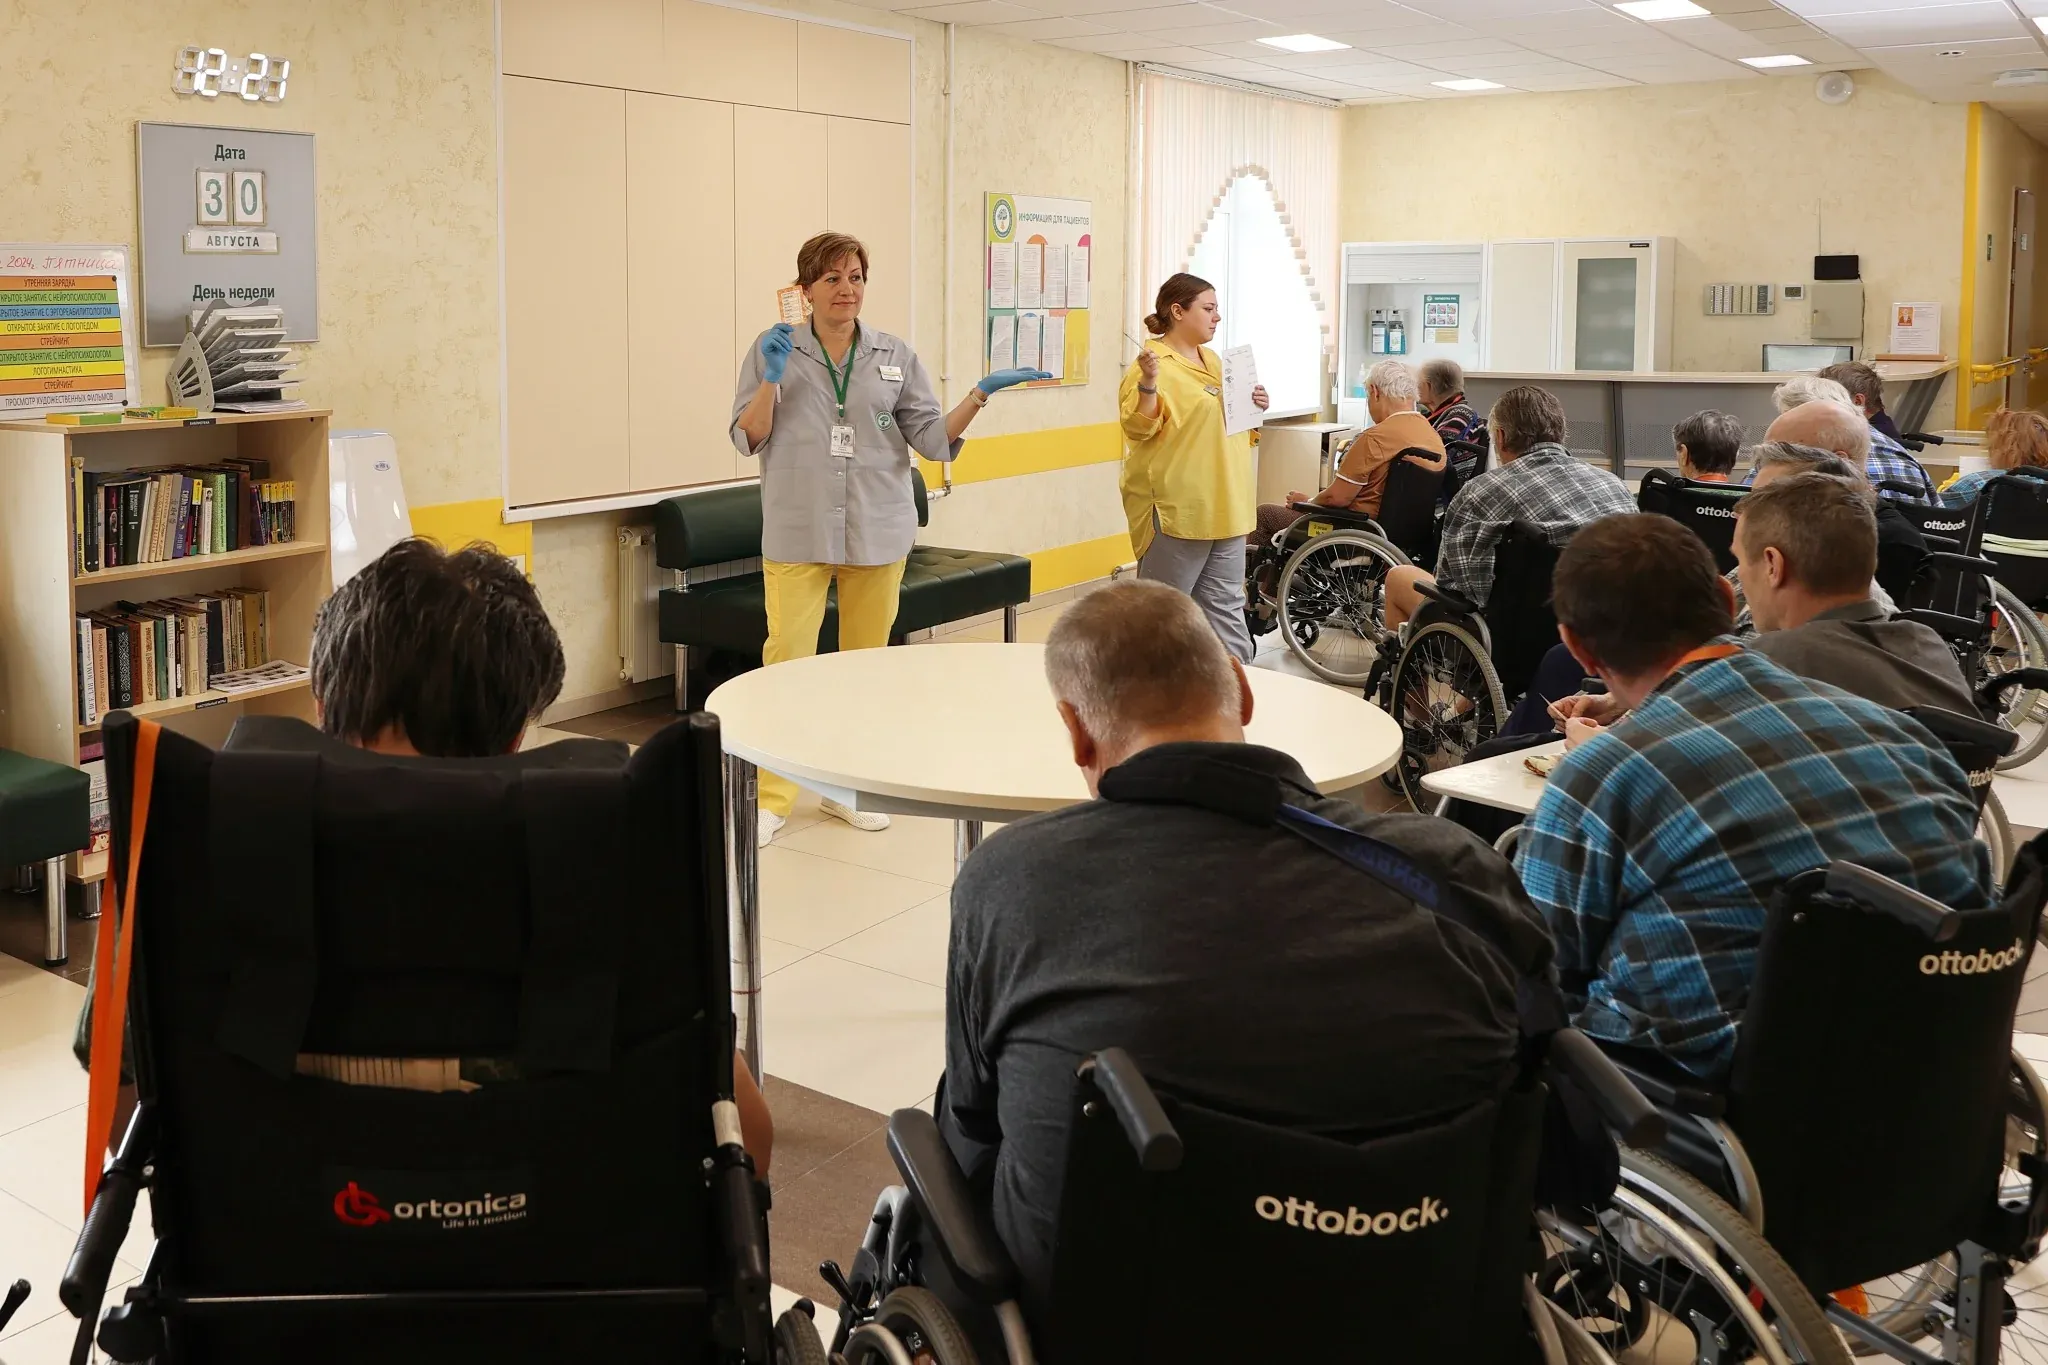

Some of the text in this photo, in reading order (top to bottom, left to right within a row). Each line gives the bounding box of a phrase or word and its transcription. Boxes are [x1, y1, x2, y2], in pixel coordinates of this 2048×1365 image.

[193, 47, 290, 101] 12:21
[214, 144, 246, 161] Дата
[1018, 212, 1090, 225] ИНФОРМАЦИЯ ДЛЯ ПАЦИЕНТОВ
[206, 235, 260, 247] АВГУСТА
[24, 278, 76, 288] УТРЕННЯЯ ЗАРЯДКА
[0, 291, 107, 303] КРЫТОЕ ЗАНЯТИЕ С НЕЙРОПСИХОЛОГОМ
[192, 284, 275, 302] День недели
[20, 308, 45, 317] ЗАНЯТИЕ
[46, 308, 50, 317] С
[50, 307, 112, 317] ЭРГОРЕАБИЛИТОЛОГОМ
[7, 321, 99, 332] ОТКРЫТОЕ ЗАНЯТИЕ С ЛОГОПЕДОМ
[40, 336, 70, 346] СТРЕЙЧИНГ
[0, 350, 112, 361] ОТКРЫТОЕ ЗАНЯТИЕ С НЕЙРОПСИХОЛОГОМ
[33, 365, 82, 376] ЛОГОГИМНАСТИКА
[44, 380, 73, 389] СТРЕЙЧИНГ
[5, 392, 113, 407] ПРОСМОТР ХУДОЖЕСТВЕННЫХ ФИЛЬМОВ
[1696, 506, 1738, 519] ottobo
[394, 1192, 526, 1219] ortonica
[442, 1210, 527, 1229] Life in motion
